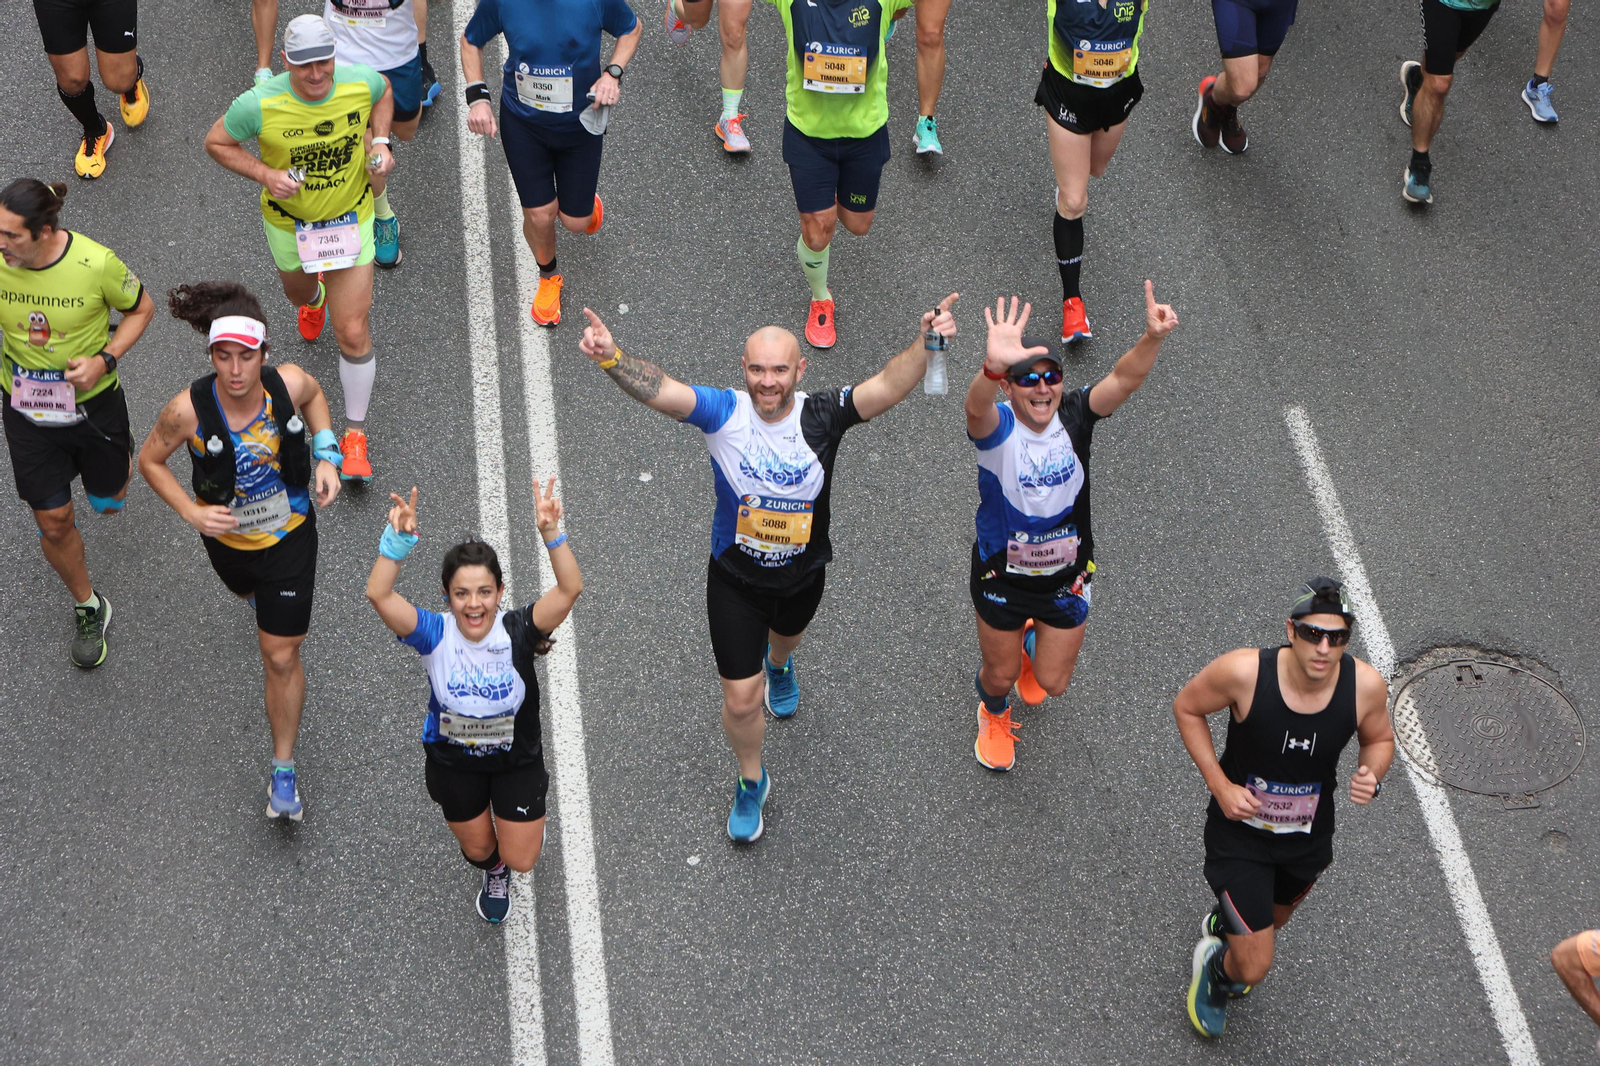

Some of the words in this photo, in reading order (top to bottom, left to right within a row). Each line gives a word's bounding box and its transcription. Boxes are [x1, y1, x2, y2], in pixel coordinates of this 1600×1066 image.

[826, 45, 861, 55] ZURICH
[1095, 41, 1126, 51] ZURICH
[824, 62, 845, 71] 5048
[1093, 58, 1114, 66] 5046
[533, 67, 566, 76] ZURICH
[1084, 69, 1100, 77] JUAN
[820, 74, 849, 83] TIMONEL
[532, 82, 553, 91] 8350
[290, 141, 326, 152] CIRCUITO
[291, 145, 353, 165] PONLE
[318, 234, 340, 244] 7345
[317, 248, 345, 258] ADOLFO
[0, 289, 85, 308] aparunners
[31, 388, 53, 396] 7224
[20, 401, 53, 409] ORLANDO
[241, 485, 278, 505] ZURICH
[765, 499, 805, 511] ZURICH
[243, 507, 267, 517] 9315
[762, 518, 787, 530] 5088
[755, 531, 791, 543] ALBERTO
[1032, 527, 1069, 543] ZURICH
[739, 544, 761, 560] BAR
[1031, 548, 1055, 558] 6834
[1019, 557, 1065, 567] CECEGOMEZ
[1271, 784, 1313, 795] ZURICH
[1267, 801, 1293, 810] 7532
